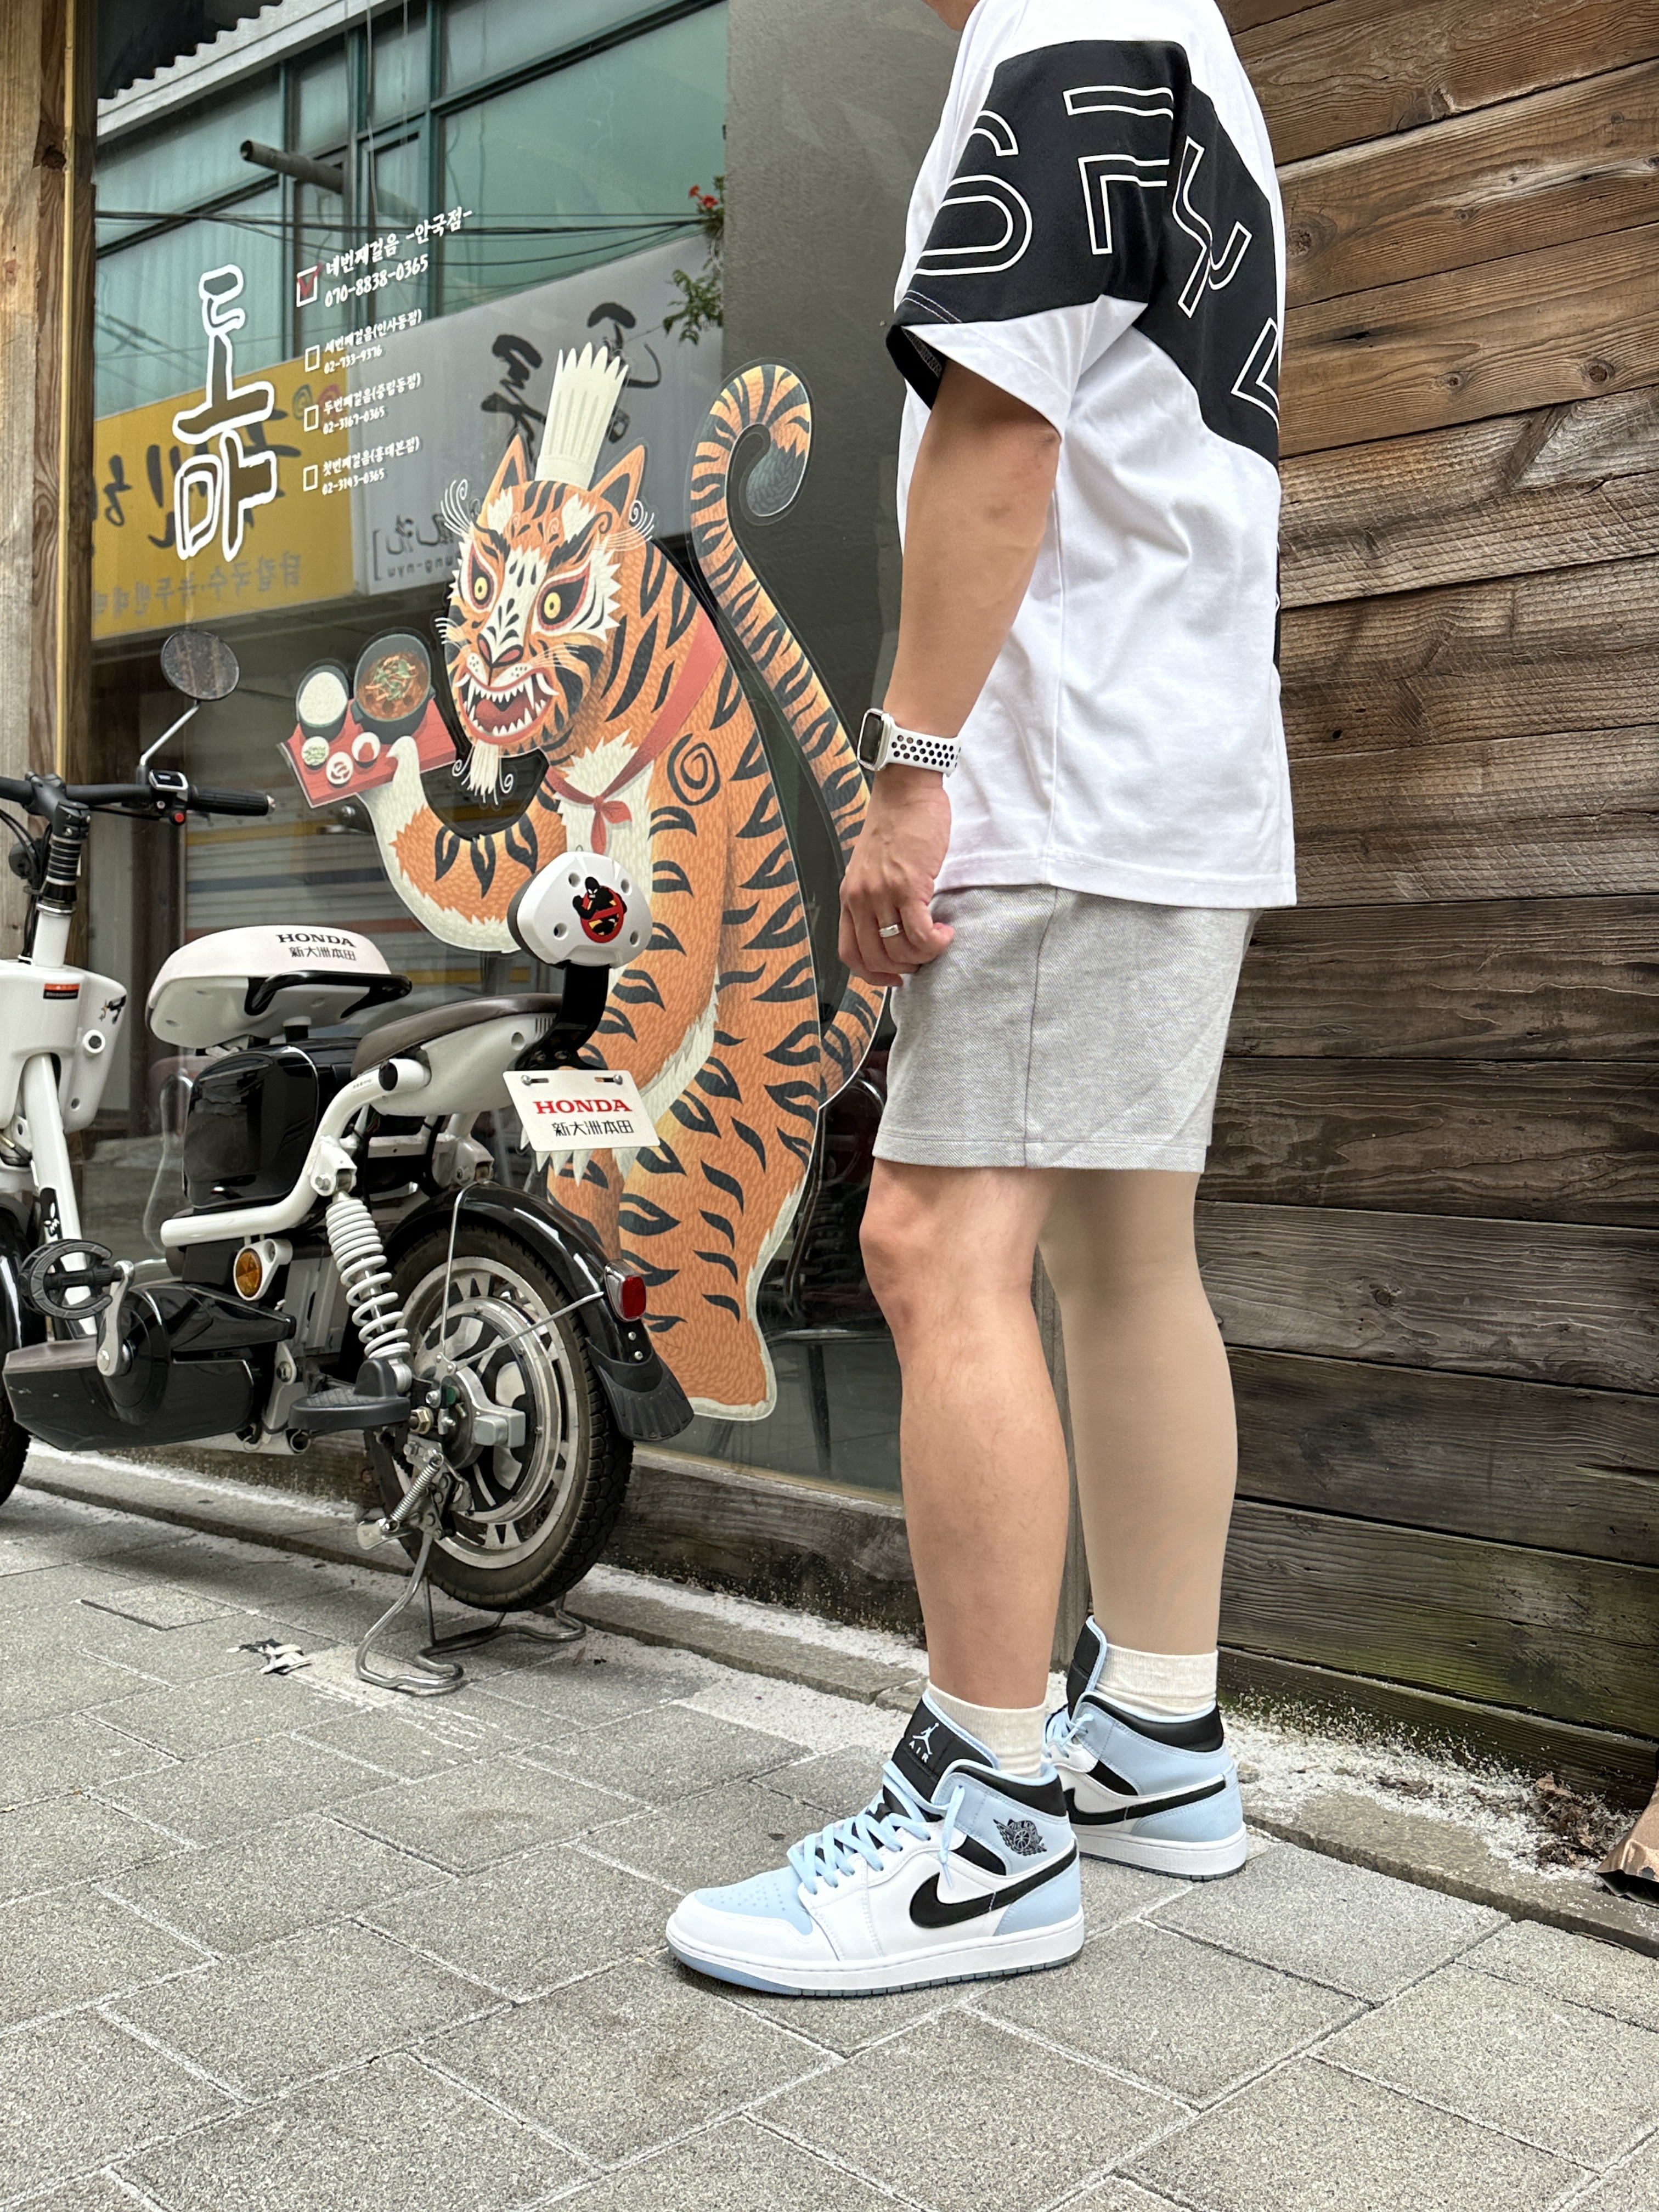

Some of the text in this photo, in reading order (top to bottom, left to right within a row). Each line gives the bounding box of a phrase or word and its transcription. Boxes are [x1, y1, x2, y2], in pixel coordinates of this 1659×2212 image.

[325, 233, 400, 278] 네번째걸음
[324, 253, 428, 308] 070-8838-0365
[324, 344, 383, 374] 02-733-9376
[323, 405, 386, 435] 02-3167-0365
[321, 467, 385, 495] 02-3143-0365
[275, 933, 357, 948] HONDA
[289, 946, 357, 961] 新大洲本田
[533, 1099, 633, 1114] HONDA
[551, 1120, 634, 1137] 新大洲本田
[909, 1740, 929, 1763] AIR
